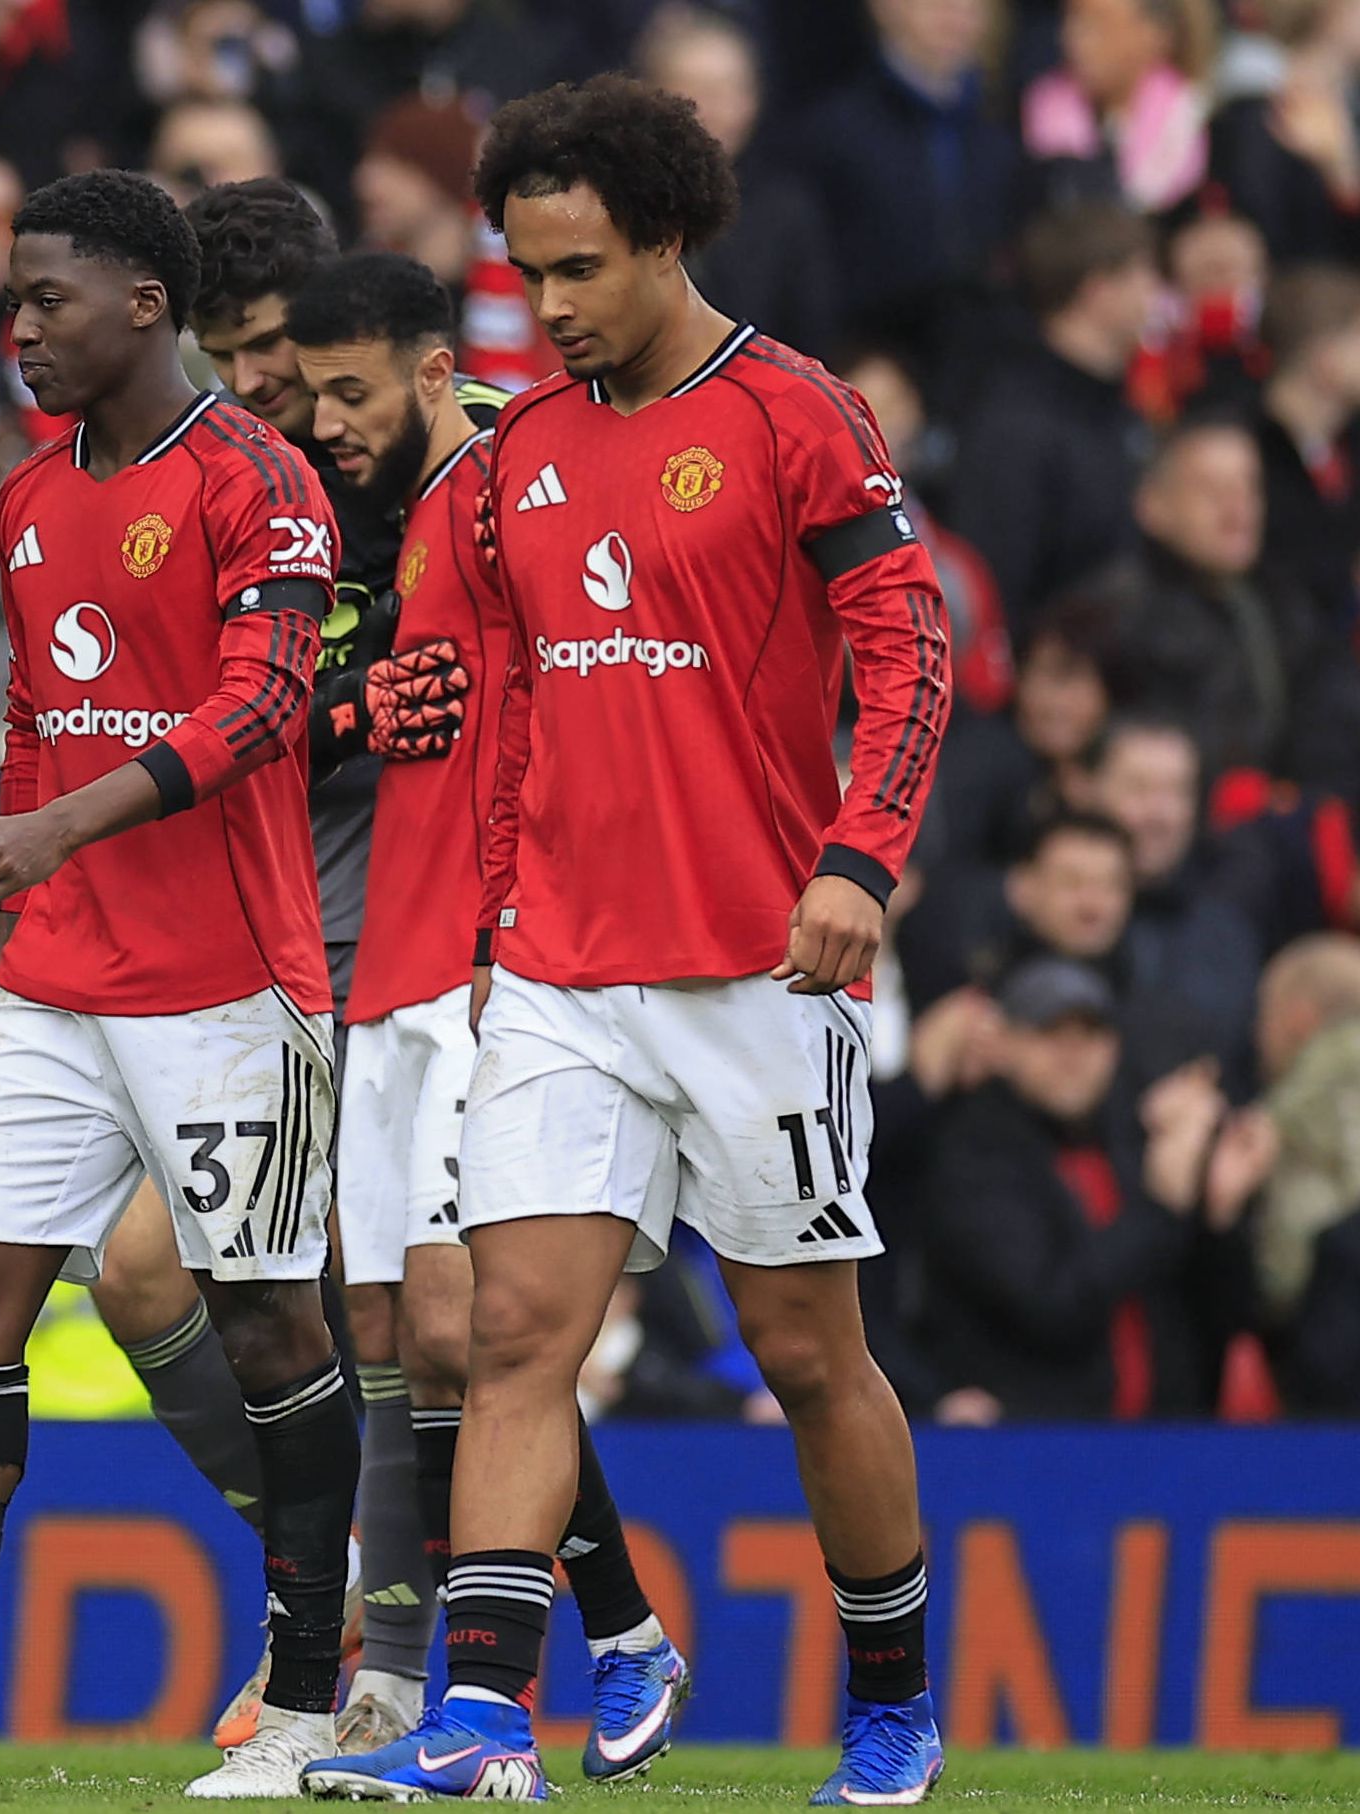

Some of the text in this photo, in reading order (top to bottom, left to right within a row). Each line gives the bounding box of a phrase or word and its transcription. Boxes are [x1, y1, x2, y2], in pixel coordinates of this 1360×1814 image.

[268, 562, 332, 580] TECHNO
[536, 627, 711, 678] Sapdragon
[177, 1121, 277, 1214] 37
[777, 1107, 852, 1201] 11
